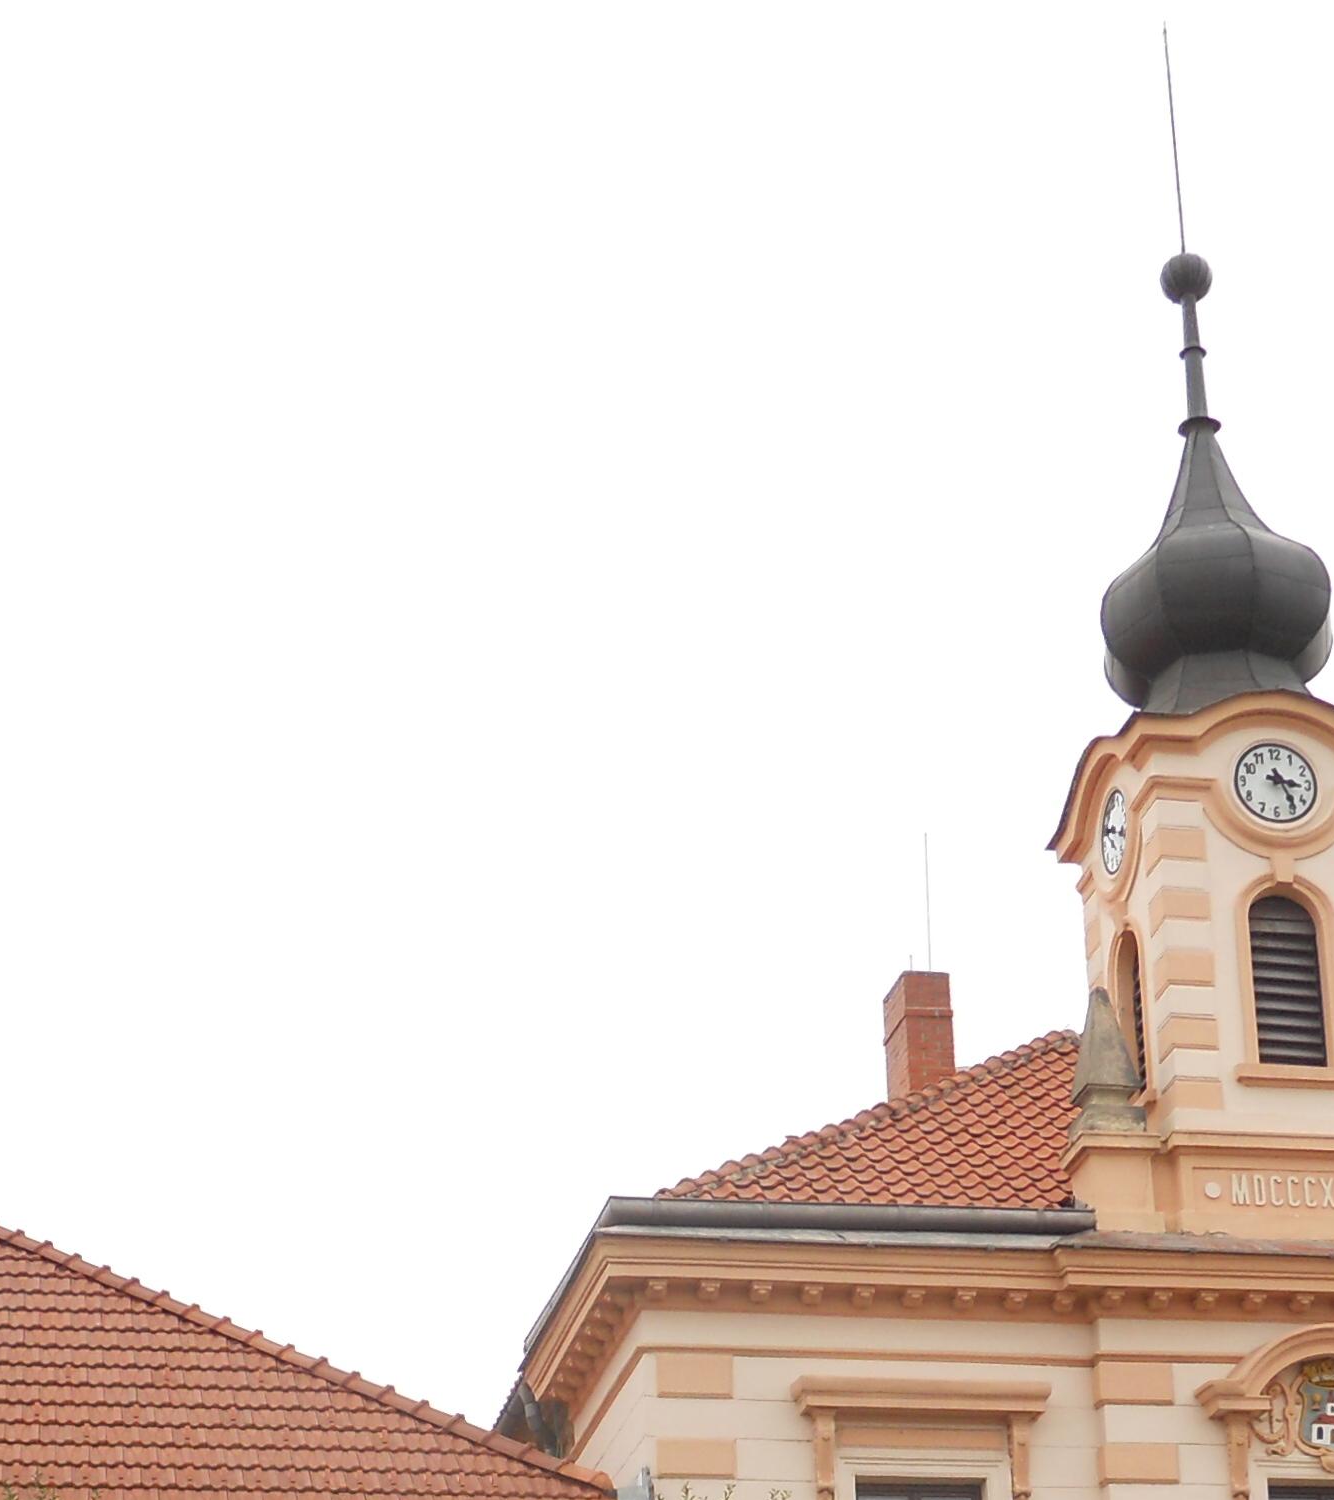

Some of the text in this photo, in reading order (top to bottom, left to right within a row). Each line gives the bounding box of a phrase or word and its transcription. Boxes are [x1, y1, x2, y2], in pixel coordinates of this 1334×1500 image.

[1253, 752, 1264, 765] 11
[1268, 748, 1281, 761] 12
[1287, 754, 1293, 767] 1
[1243, 762, 1256, 775] 10
[1298, 765, 1306, 777] 2
[1239, 775, 1247, 787] 9
[1303, 780, 1312, 792] 3
[1245, 790, 1253, 802] 8
[1299, 794, 1307, 806] 4
[1258, 801, 1266, 814] 7
[1273, 806, 1281, 818] 6
